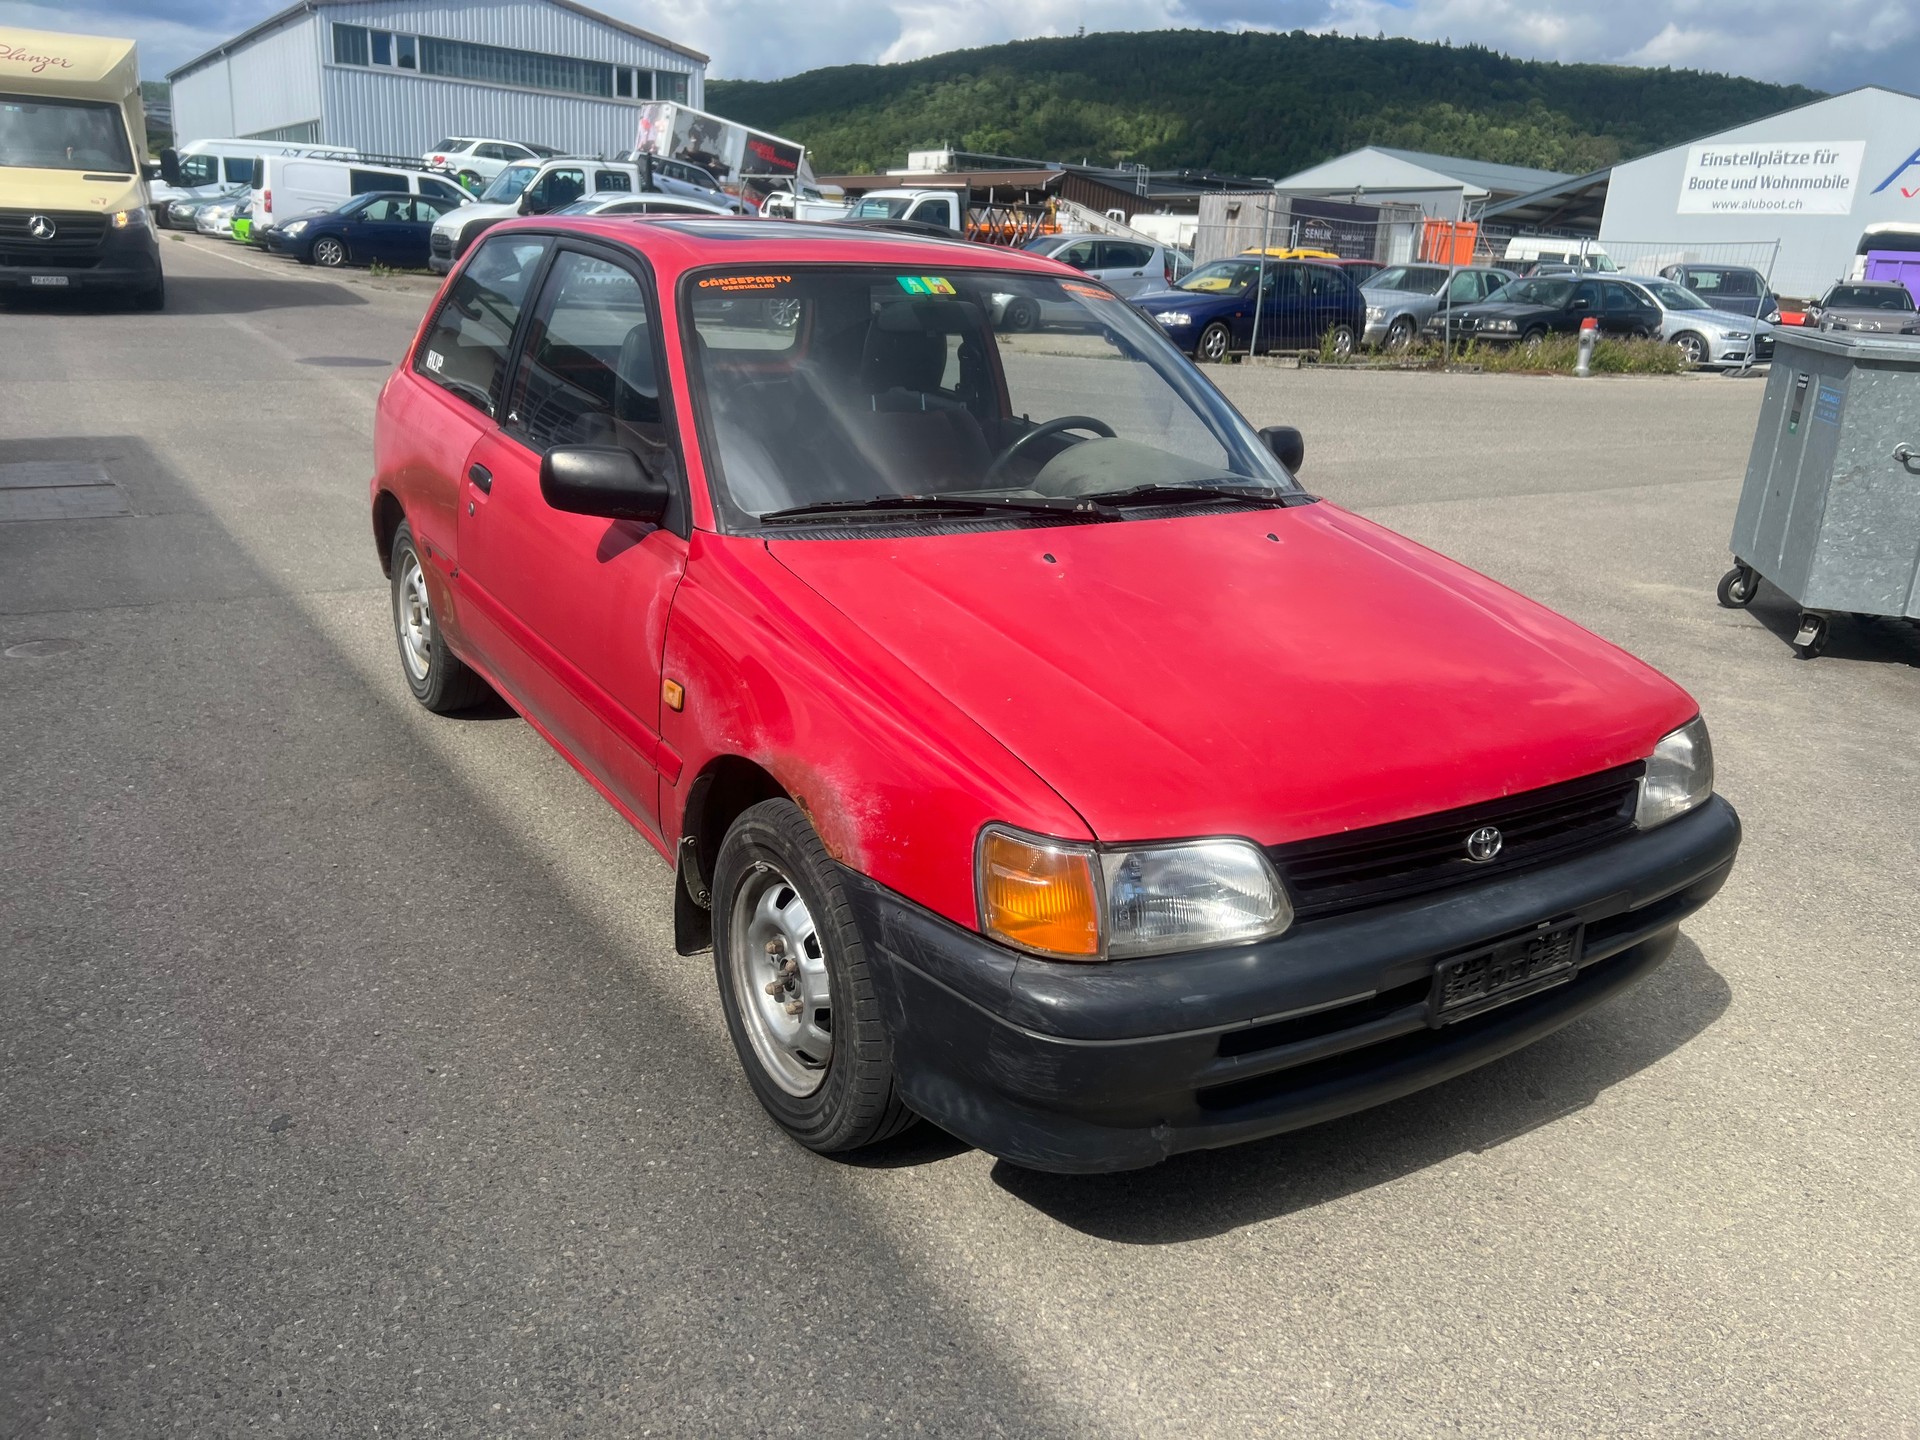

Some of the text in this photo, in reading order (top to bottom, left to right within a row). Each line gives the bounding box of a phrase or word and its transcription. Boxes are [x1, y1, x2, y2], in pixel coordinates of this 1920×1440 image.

[1700, 149, 1839, 168] Einstellplätze für
[1688, 175, 1849, 190] Boote und Wohnmobile
[1712, 199, 1803, 209] www.aluboot.ch
[699, 275, 791, 288] GÄNSEPARTY
